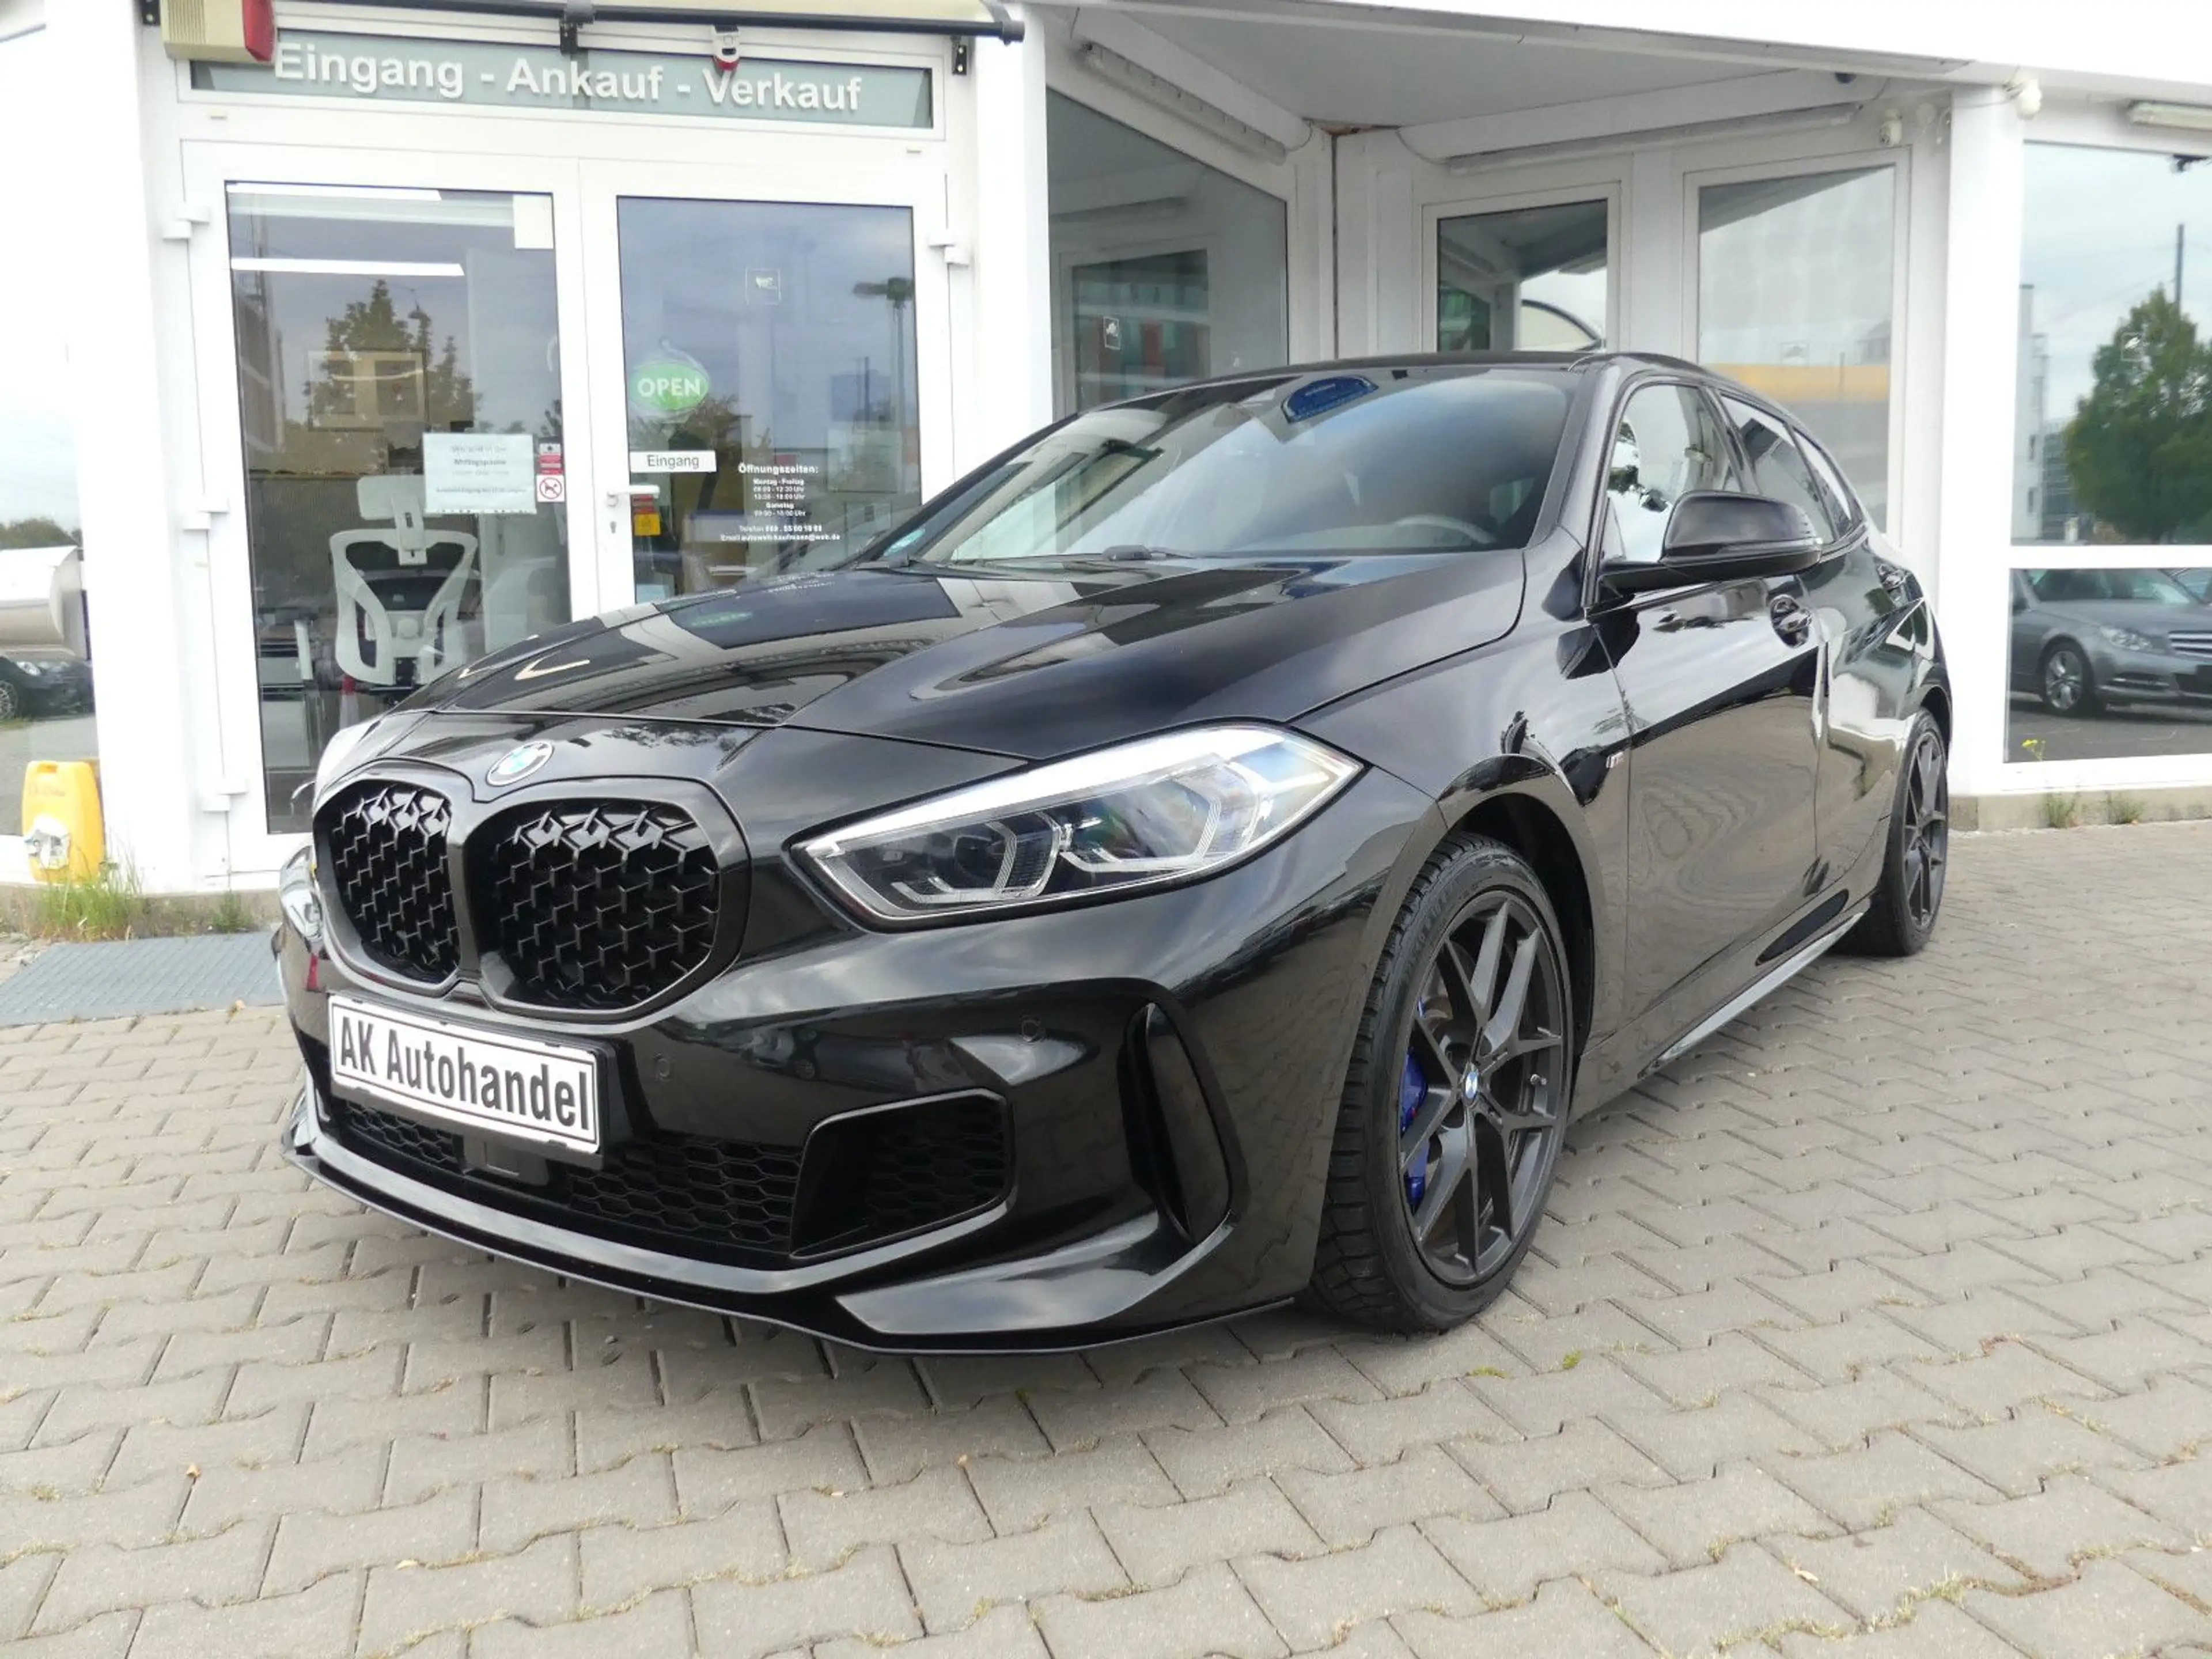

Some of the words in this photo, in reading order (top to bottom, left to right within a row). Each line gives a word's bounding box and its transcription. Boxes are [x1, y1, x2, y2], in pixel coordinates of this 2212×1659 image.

[275, 43, 463, 99] Eingang
[506, 58, 663, 100] Ankauf
[702, 63, 862, 110] Verkauf
[637, 377, 700, 397] OPEN
[646, 454, 699, 470] Eingang
[738, 461, 819, 475] Öffnungszeiten:
[341, 1016, 377, 1075] AK
[387, 1029, 590, 1130] Autohandel
